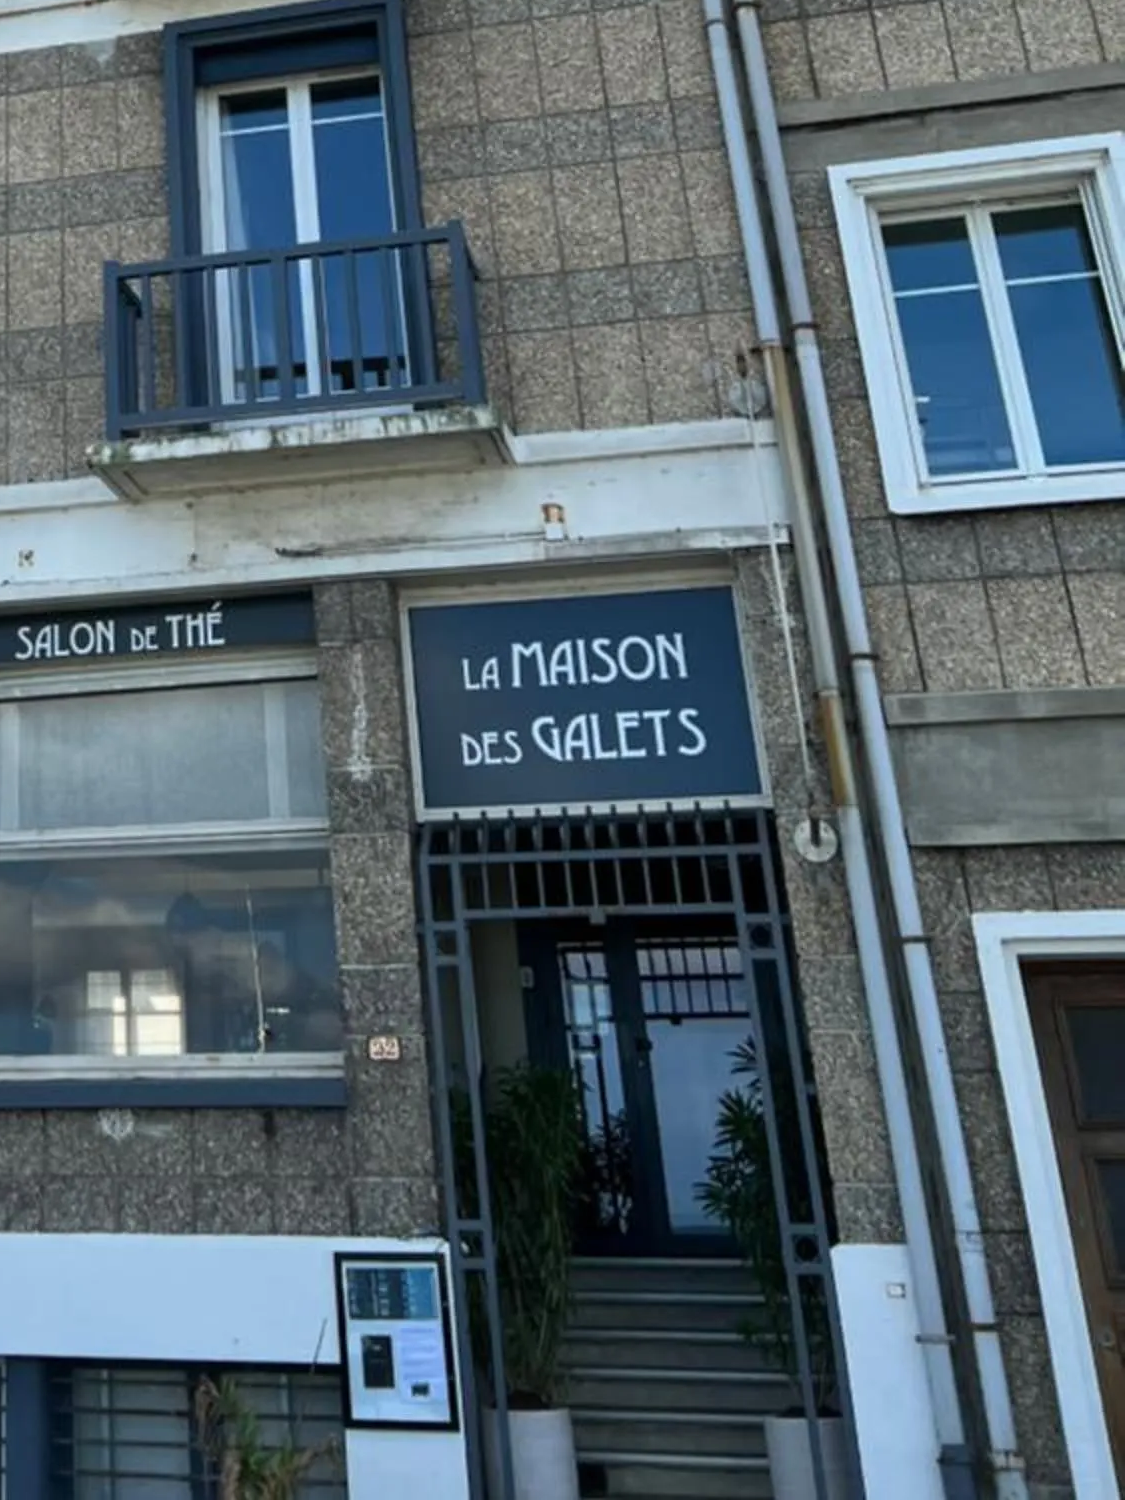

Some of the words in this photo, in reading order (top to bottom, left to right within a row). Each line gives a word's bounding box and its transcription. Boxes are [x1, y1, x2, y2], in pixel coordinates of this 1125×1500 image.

[15, 620, 116, 660] SALON
[165, 602, 225, 648] THÉ
[462, 656, 501, 691] LA
[511, 632, 689, 688] MAISON
[460, 731, 523, 766] DES
[531, 708, 707, 761] GALETS
